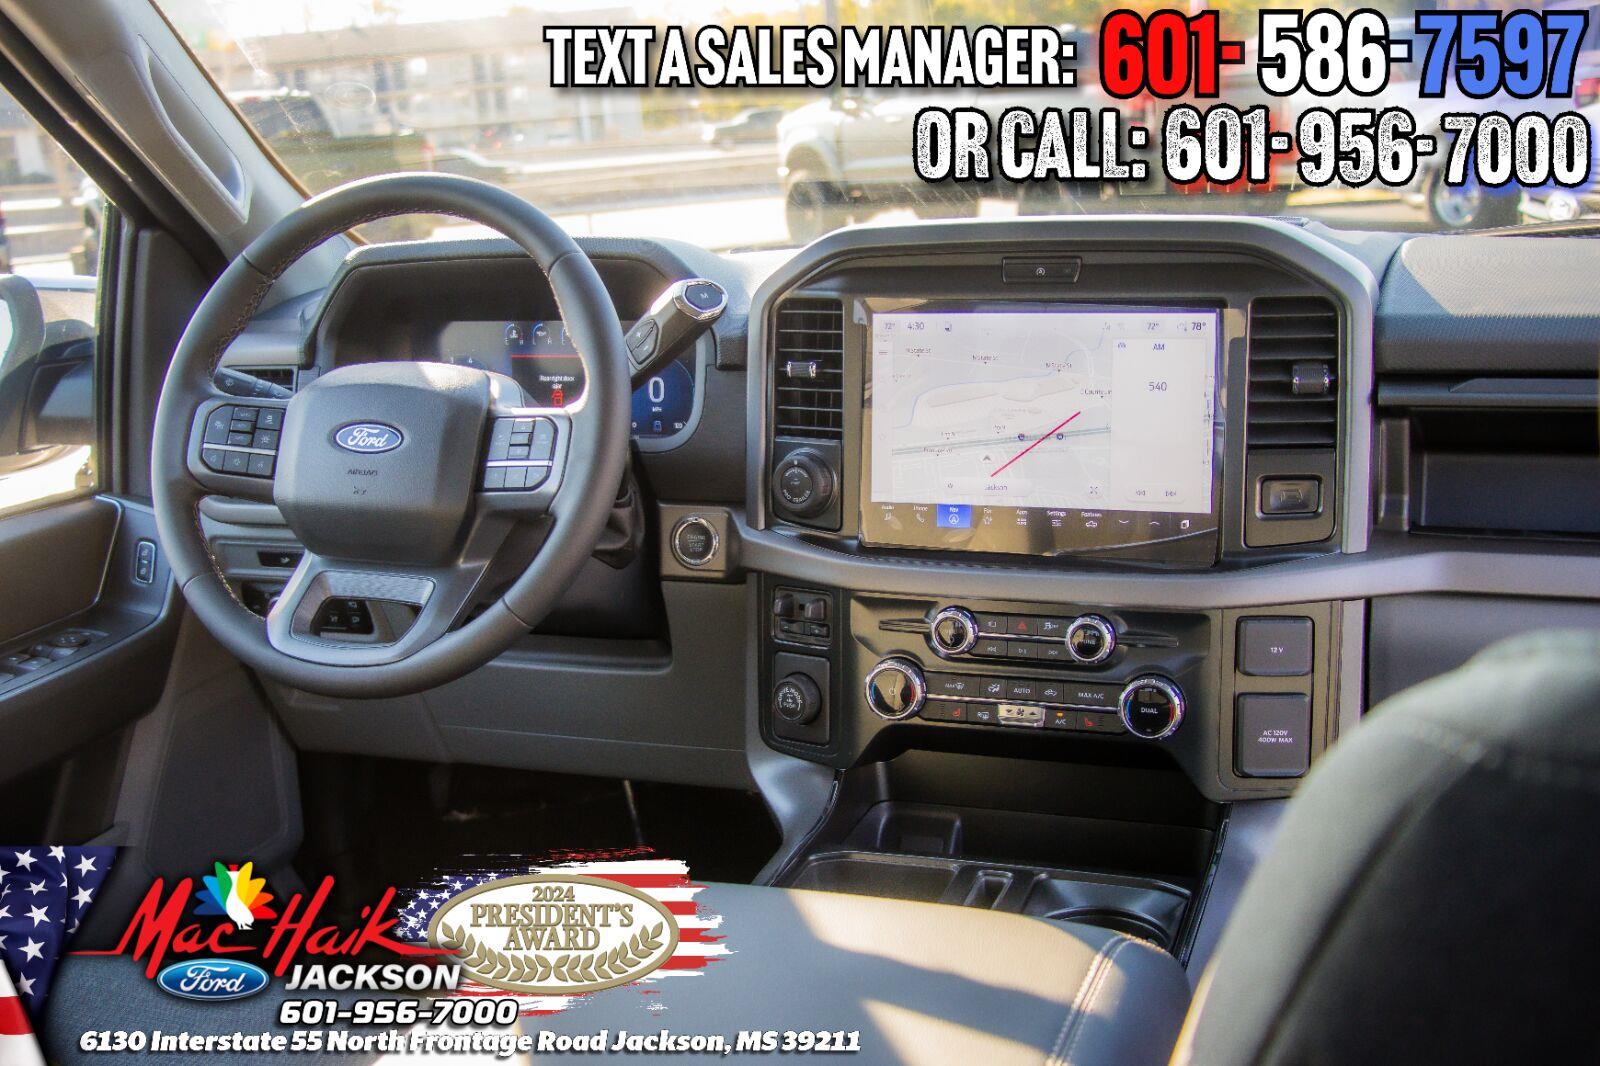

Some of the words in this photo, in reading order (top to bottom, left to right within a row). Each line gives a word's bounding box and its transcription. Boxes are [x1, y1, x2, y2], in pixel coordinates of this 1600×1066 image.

[907, 321, 925, 331] 4:30
[1191, 322, 1206, 331] 78°
[649, 376, 664, 403] 0
[1148, 381, 1167, 392] 540
[348, 427, 388, 447] Ford
[1013, 687, 1031, 695] AUTO
